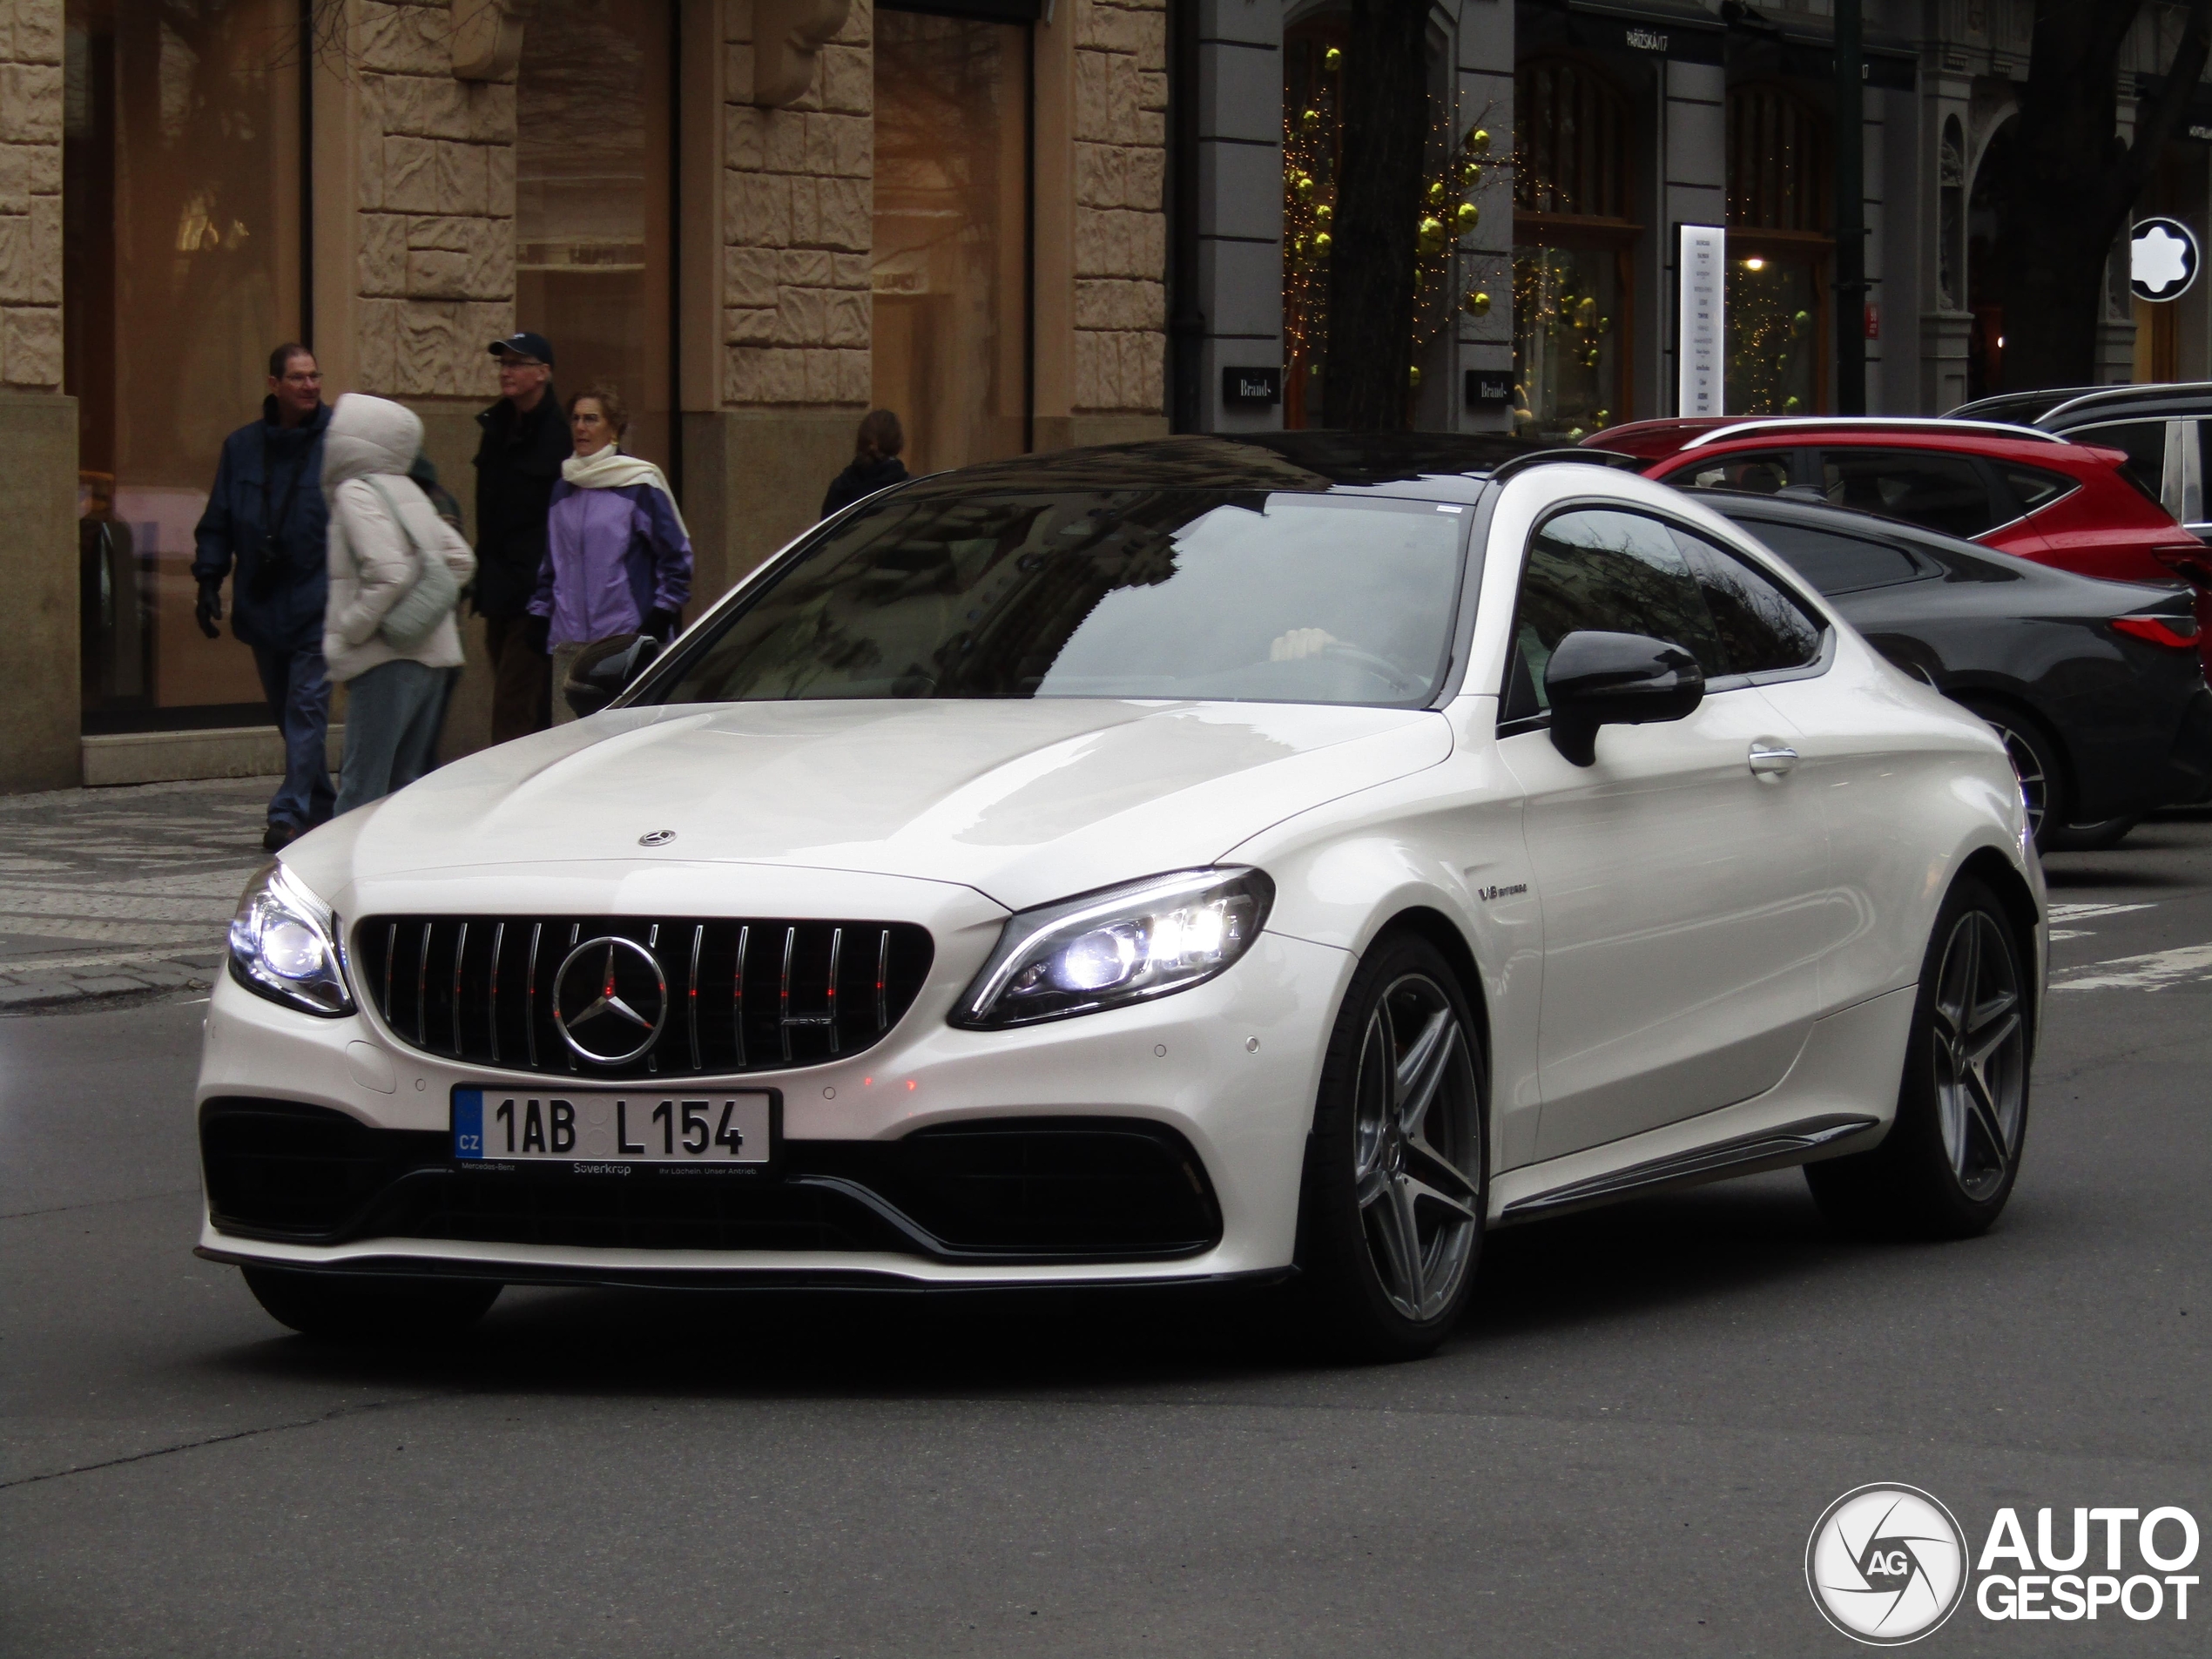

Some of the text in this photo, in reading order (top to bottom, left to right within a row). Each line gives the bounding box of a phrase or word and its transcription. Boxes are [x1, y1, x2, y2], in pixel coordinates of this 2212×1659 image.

[496, 1098, 744, 1155] 1AB L154
[460, 1134, 480, 1150] CZ
[462, 1163, 516, 1171] Mercedes-Benz
[574, 1163, 631, 1176] Süverkrüp
